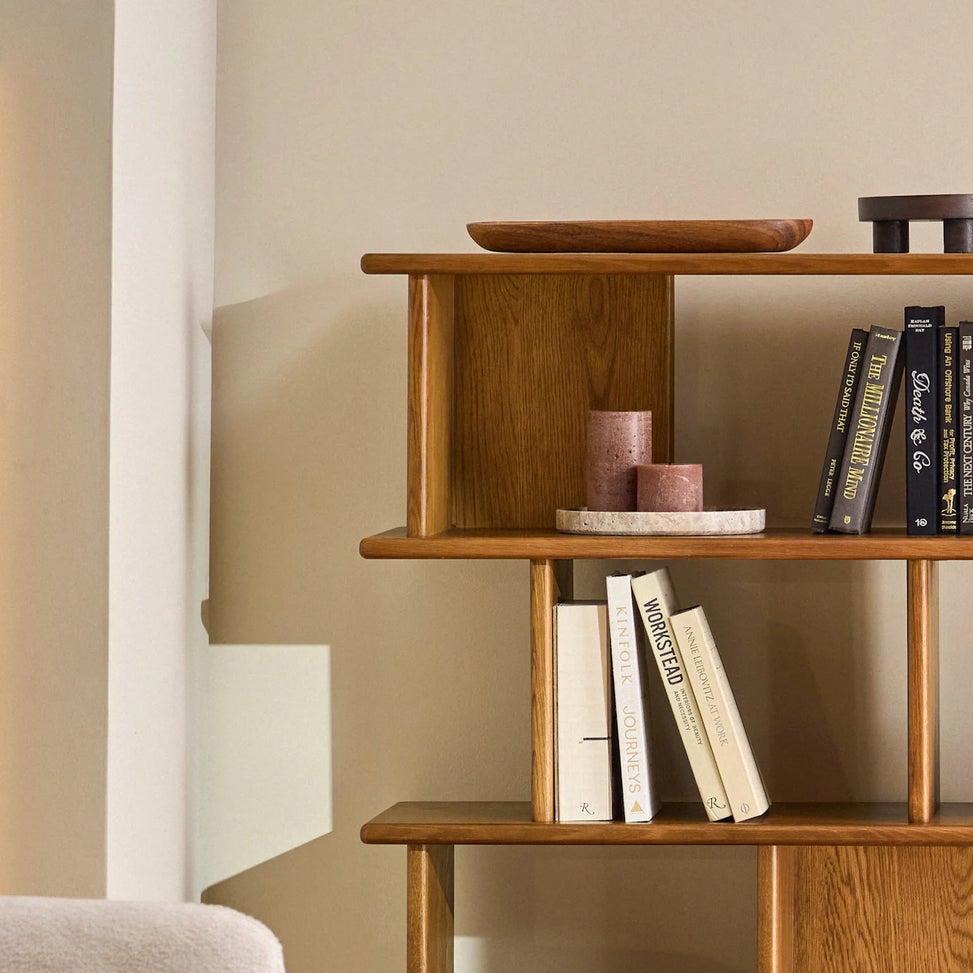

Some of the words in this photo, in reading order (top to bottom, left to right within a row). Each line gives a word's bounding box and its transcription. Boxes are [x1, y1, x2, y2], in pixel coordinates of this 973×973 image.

[853, 342, 861, 351] IF
[944, 332, 952, 354] Using
[848, 351, 860, 374] ONLY
[868, 354, 887, 380] THE
[944, 356, 952, 367] An
[846, 374, 855, 386] I'D
[944, 370, 952, 403] Offshore
[841, 386, 852, 408] SAID
[911, 370, 930, 424] Death
[836, 408, 848, 432] THAT
[850, 382, 884, 466] MILLIONAIRE
[944, 404, 952, 424] Bank
[910, 428, 927, 446] &
[963, 413, 973, 454] CENTURY
[913, 451, 931, 473] Co
[963, 455, 973, 478] NEXT
[844, 466, 864, 500] MIND
[964, 478, 973, 497] THE
[616, 606, 632, 685] KINFOLK
[644, 598, 684, 686] WORKSTEAD
[684, 626, 700, 655] ANNIE
[693, 656, 714, 702] LEIBOVITZ
[708, 703, 718, 714] AT
[713, 713, 729, 747] WORK
[678, 702, 691, 731] NECESSITY
[680, 688, 691, 716] INTERIORS
[692, 723, 703, 745] BEAUTY
[622, 706, 641, 793] JOURNEYS
